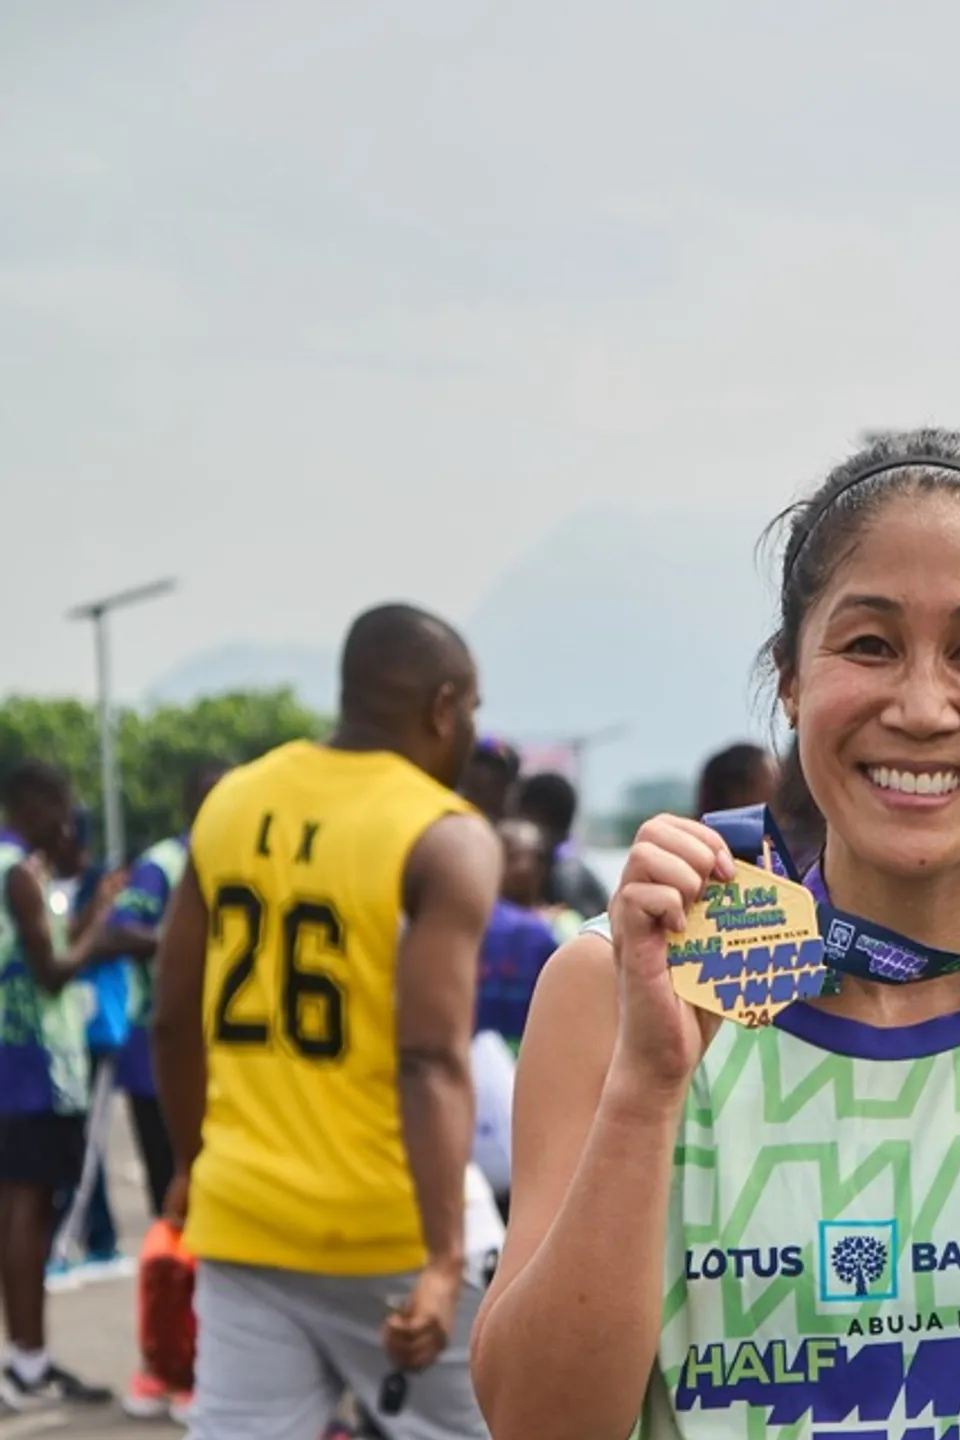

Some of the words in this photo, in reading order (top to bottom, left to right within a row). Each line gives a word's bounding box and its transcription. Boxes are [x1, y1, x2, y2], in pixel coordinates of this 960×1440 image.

[211, 886, 348, 1060] 26
[685, 1245, 804, 1280] LOTUS
[848, 1313, 944, 1336] ABUJA
[685, 1336, 840, 1390] HALF
